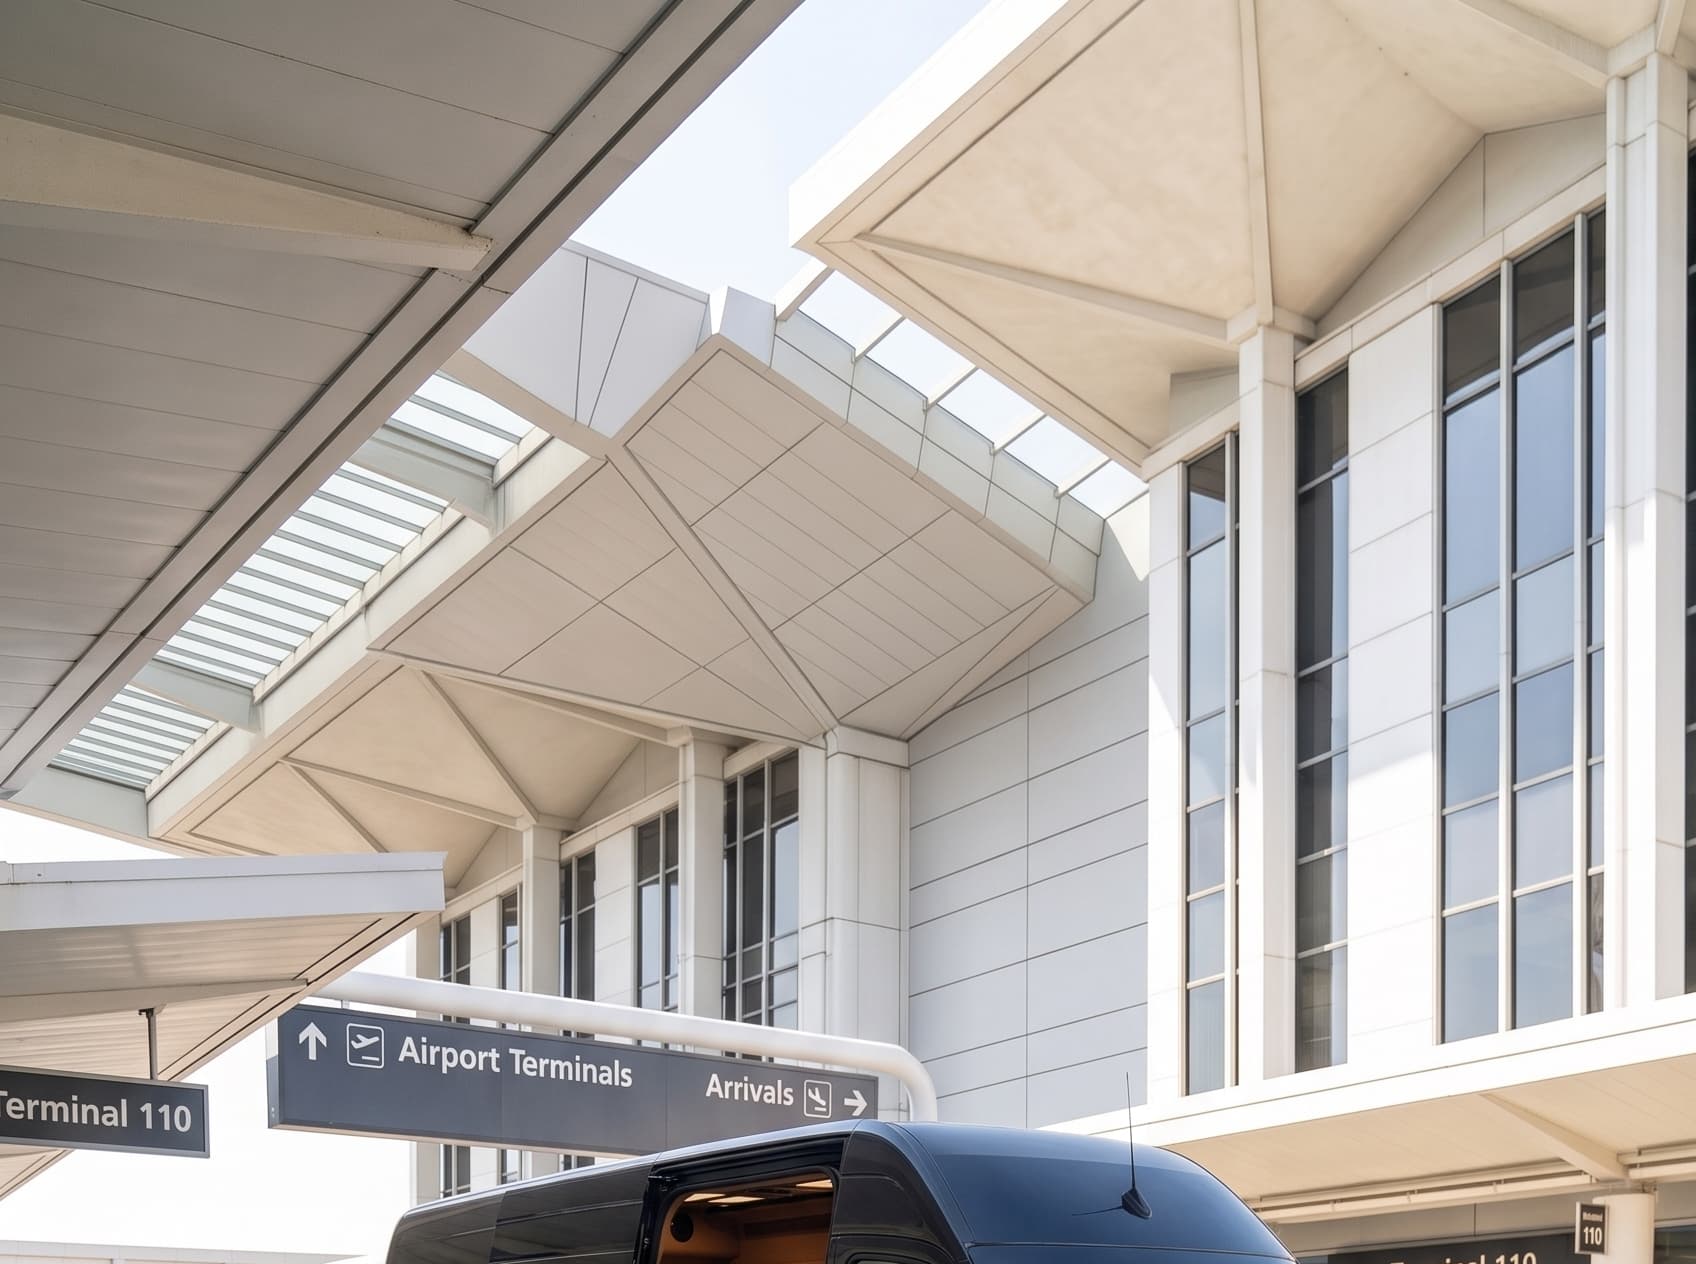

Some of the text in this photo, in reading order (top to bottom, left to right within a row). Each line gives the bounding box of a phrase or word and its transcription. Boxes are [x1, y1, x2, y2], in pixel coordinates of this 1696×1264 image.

[398, 1036, 633, 1088] Airport Terminals
[705, 1073, 794, 1106] Arrivals
[139, 1102, 192, 1133] 110
[1583, 1226, 1603, 1246] 110
